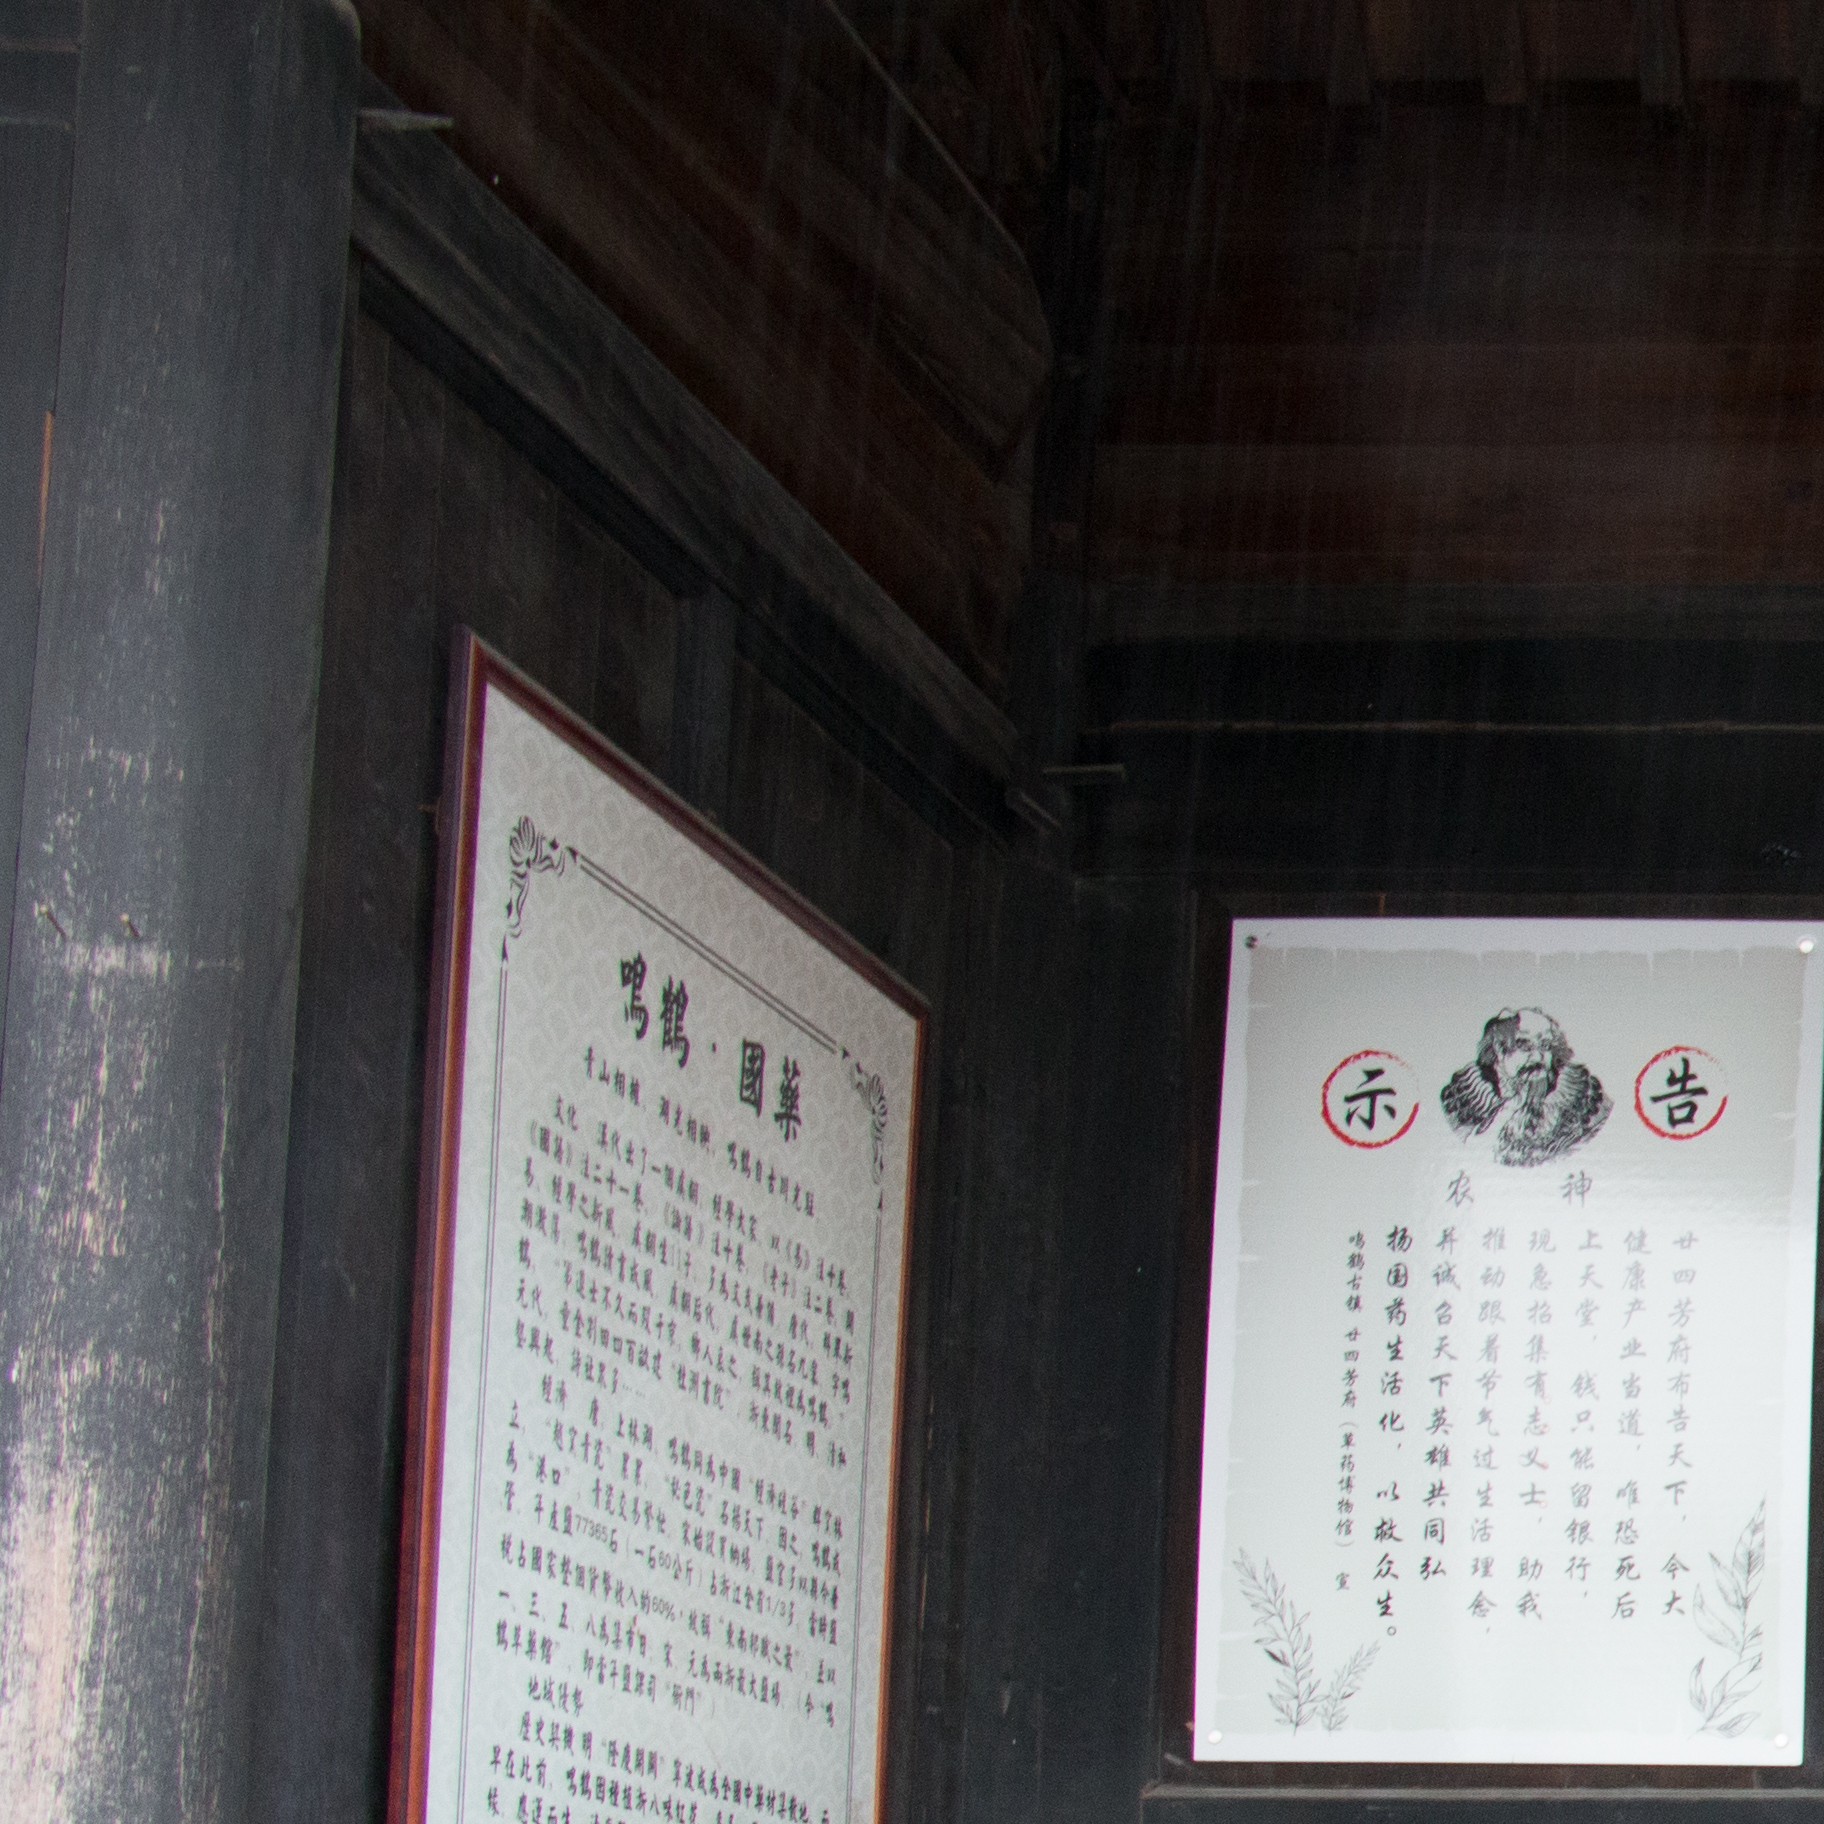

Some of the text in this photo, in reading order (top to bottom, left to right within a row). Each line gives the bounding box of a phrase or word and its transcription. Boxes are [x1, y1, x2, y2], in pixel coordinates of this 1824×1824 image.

[619, 950, 801, 1142] 鳴鶴·國藥
[1343, 1057, 1708, 1130] 告 示
[1444, 1170, 1593, 1204] 神 农
